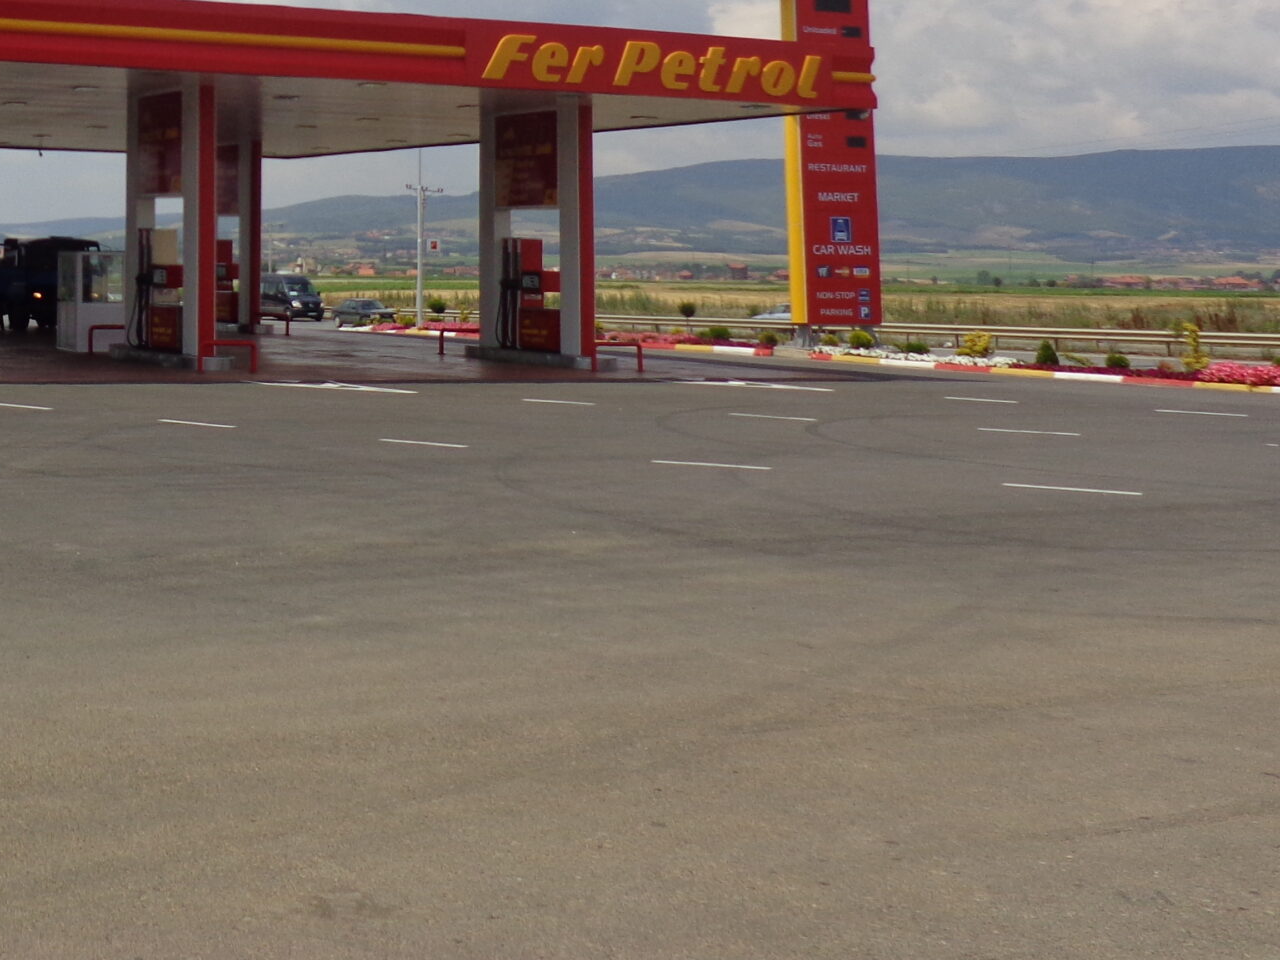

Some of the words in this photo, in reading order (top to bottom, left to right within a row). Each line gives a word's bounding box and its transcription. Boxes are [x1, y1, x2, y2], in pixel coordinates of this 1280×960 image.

[481, 34, 604, 84] Fer
[613, 40, 822, 99] Petrol
[808, 163, 867, 173] RESTAURANT
[818, 192, 860, 203] MARKET
[812, 244, 834, 255] CAR
[837, 244, 872, 256] WASH
[816, 291, 856, 300] NON-STOP
[820, 308, 853, 317] PARKING
